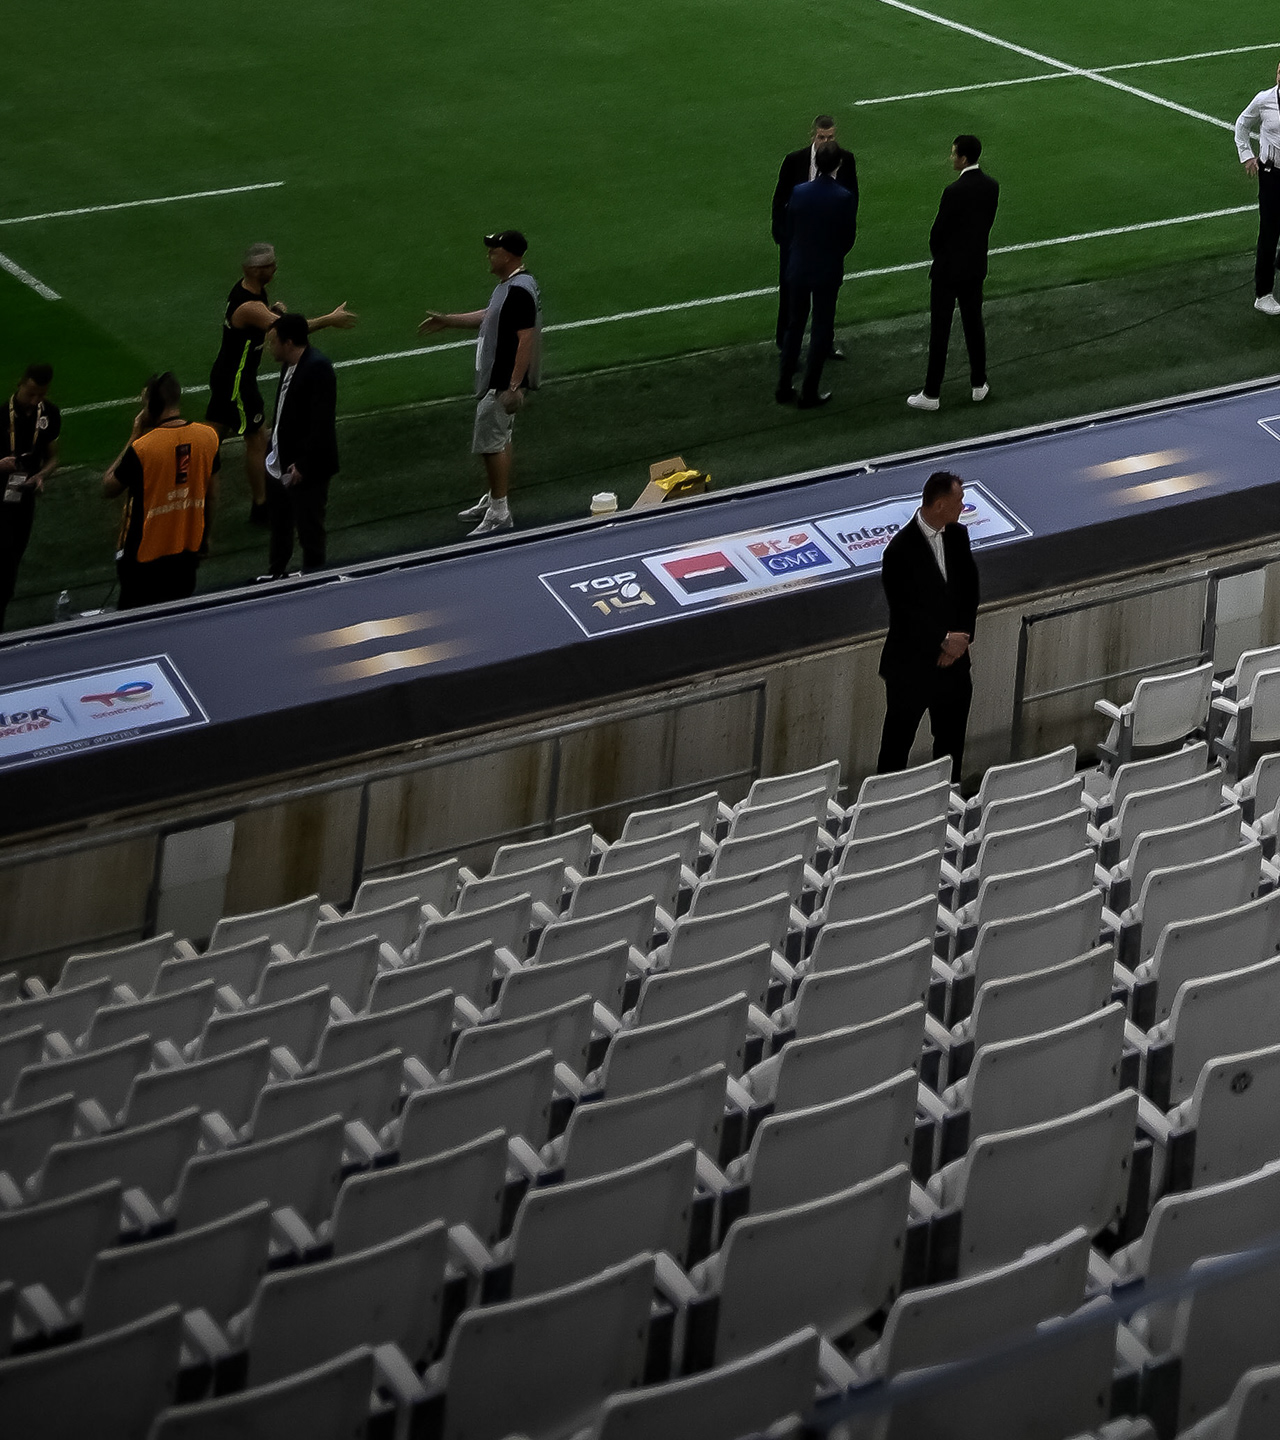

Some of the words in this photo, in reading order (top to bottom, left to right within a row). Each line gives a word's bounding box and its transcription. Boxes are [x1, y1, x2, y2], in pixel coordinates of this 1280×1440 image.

[768, 547, 821, 572] GMF
[570, 571, 638, 592] TOP
[592, 591, 656, 615] 14
